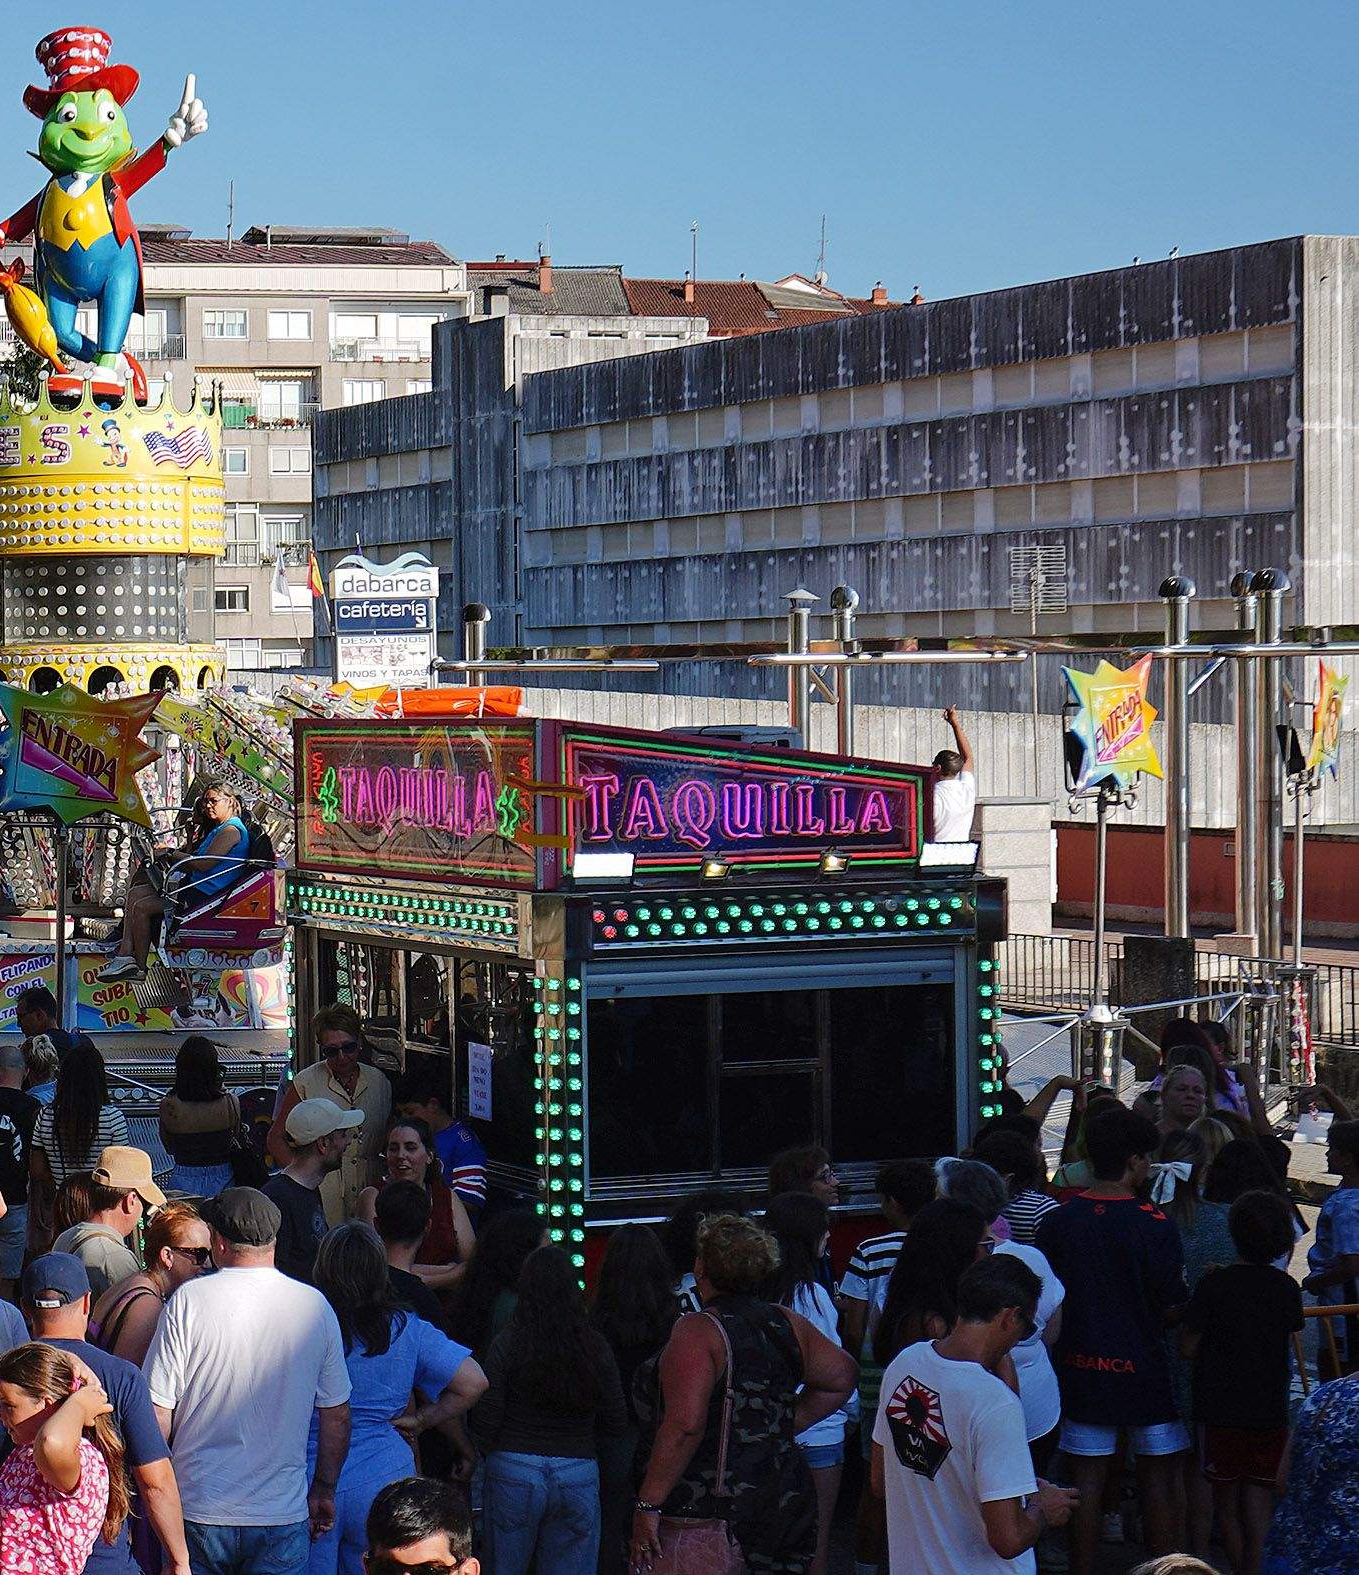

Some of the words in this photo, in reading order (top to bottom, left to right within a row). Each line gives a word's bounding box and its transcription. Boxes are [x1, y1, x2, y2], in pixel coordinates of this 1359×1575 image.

[342, 574, 432, 593] dabarca
[339, 600, 427, 618] cafetería
[340, 636, 427, 645] DESAYUNOS
[342, 669, 377, 678] VINOS
[380, 669, 388, 677] Y
[390, 668, 428, 678] TAPAS
[23, 708, 119, 793] ENTRADA
[337, 766, 496, 838] TAQUILLA
[579, 773, 893, 849] TAQUILLA
[0, 954, 56, 982] FLIPAND
